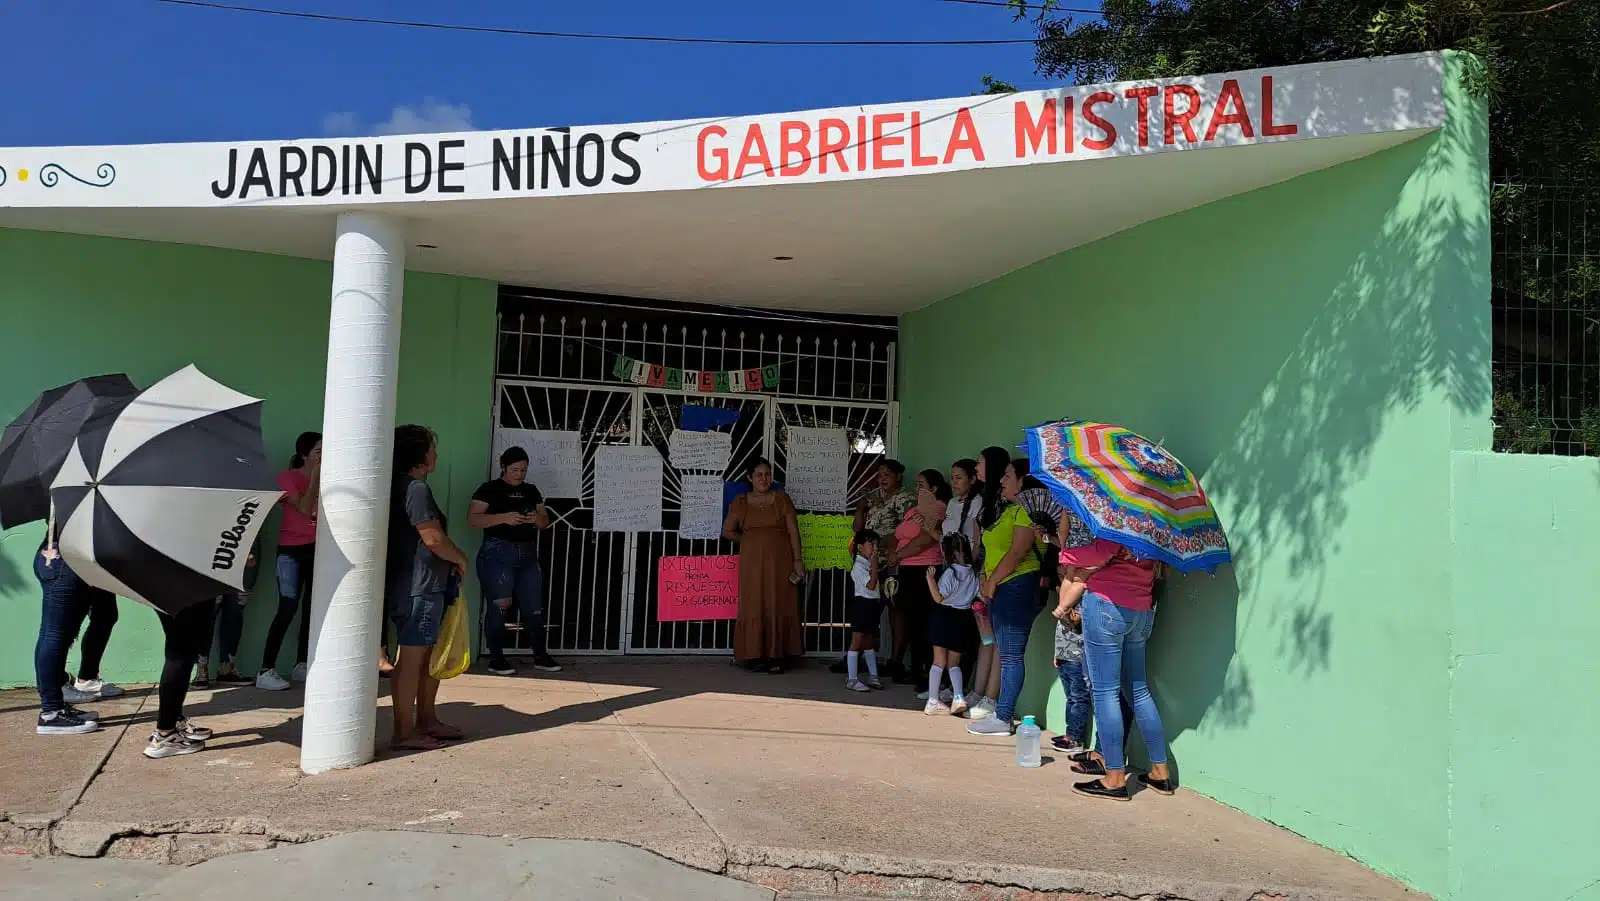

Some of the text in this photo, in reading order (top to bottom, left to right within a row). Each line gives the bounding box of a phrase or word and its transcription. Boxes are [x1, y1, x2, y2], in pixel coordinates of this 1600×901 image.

[211, 75, 1298, 199] JARDIN DE NIÑOS GABRIELA MISTRAL
[211, 502, 259, 570] Wilson
[663, 556, 736, 572] EXIGIMOS
[664, 581, 733, 593] RESPUESTA
